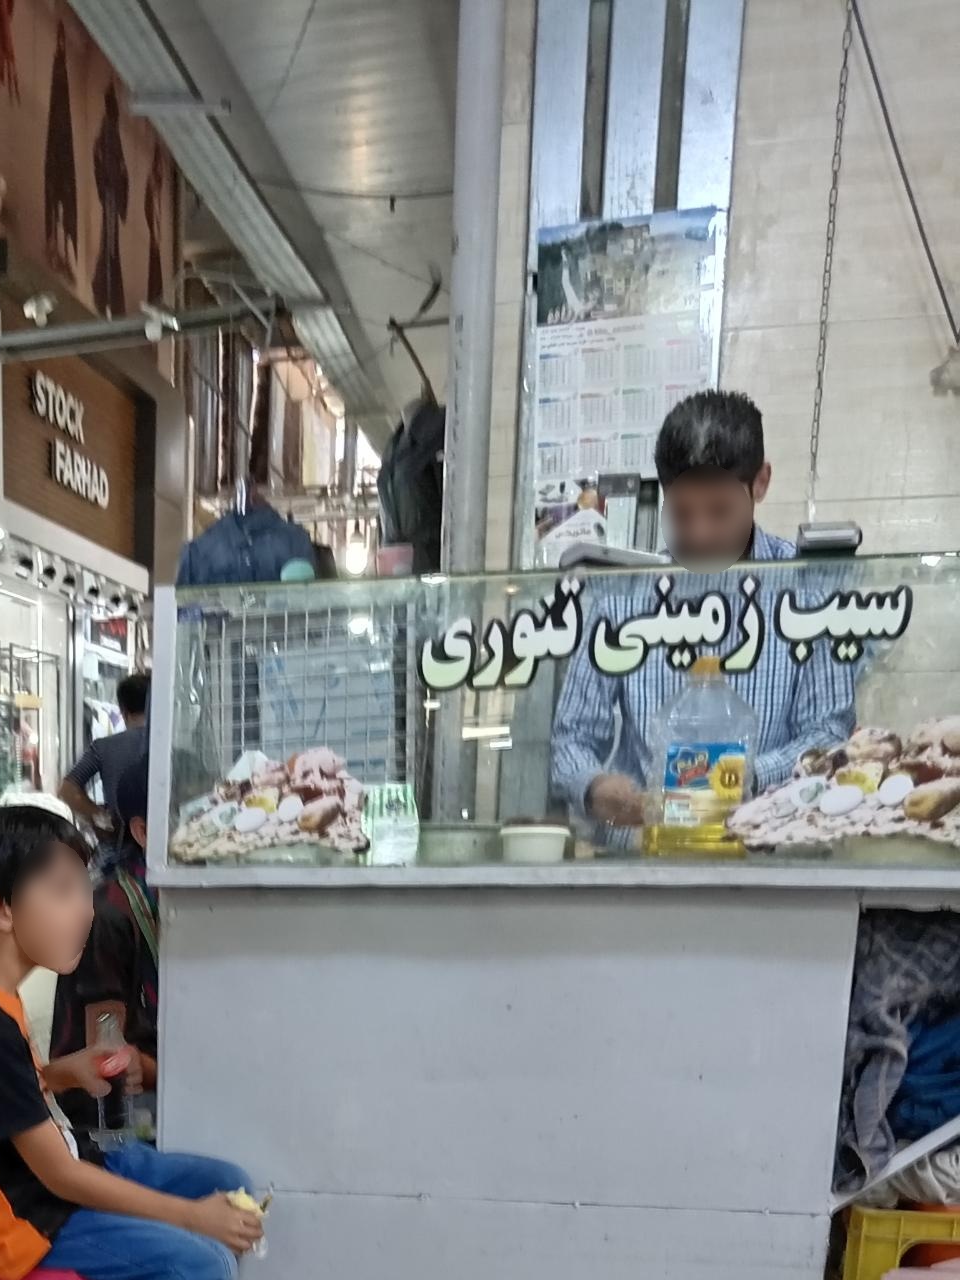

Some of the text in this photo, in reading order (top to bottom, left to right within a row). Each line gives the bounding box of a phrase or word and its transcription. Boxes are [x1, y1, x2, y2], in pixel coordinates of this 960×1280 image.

[32, 369, 85, 445] STOCK
[54, 438, 110, 510] FARHAD
[421, 574, 913, 689] سیب زمینی تنوری
